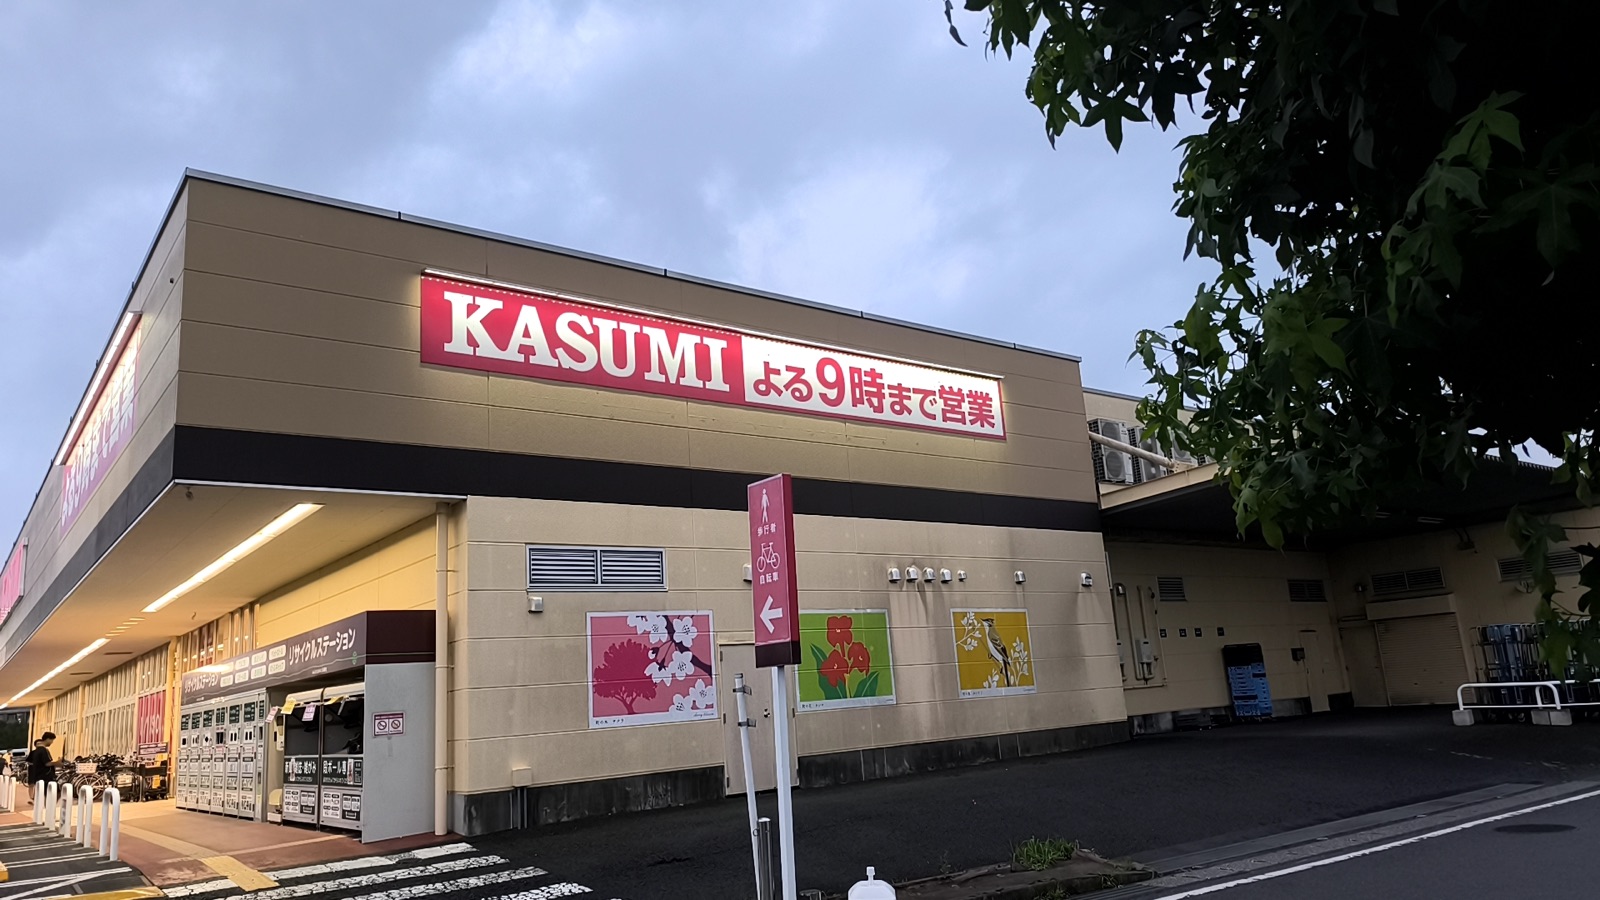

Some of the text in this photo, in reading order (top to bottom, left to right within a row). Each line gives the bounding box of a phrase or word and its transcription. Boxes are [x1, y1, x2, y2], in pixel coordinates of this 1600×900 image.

[443, 291, 730, 393] KASUMI
[752, 357, 996, 429] よる9時まで営業
[757, 523, 777, 537] 歩行者
[759, 572, 779, 585] 自転車
[289, 628, 356, 665] リサイクルステーション
[323, 760, 349, 775] 段ボール専
